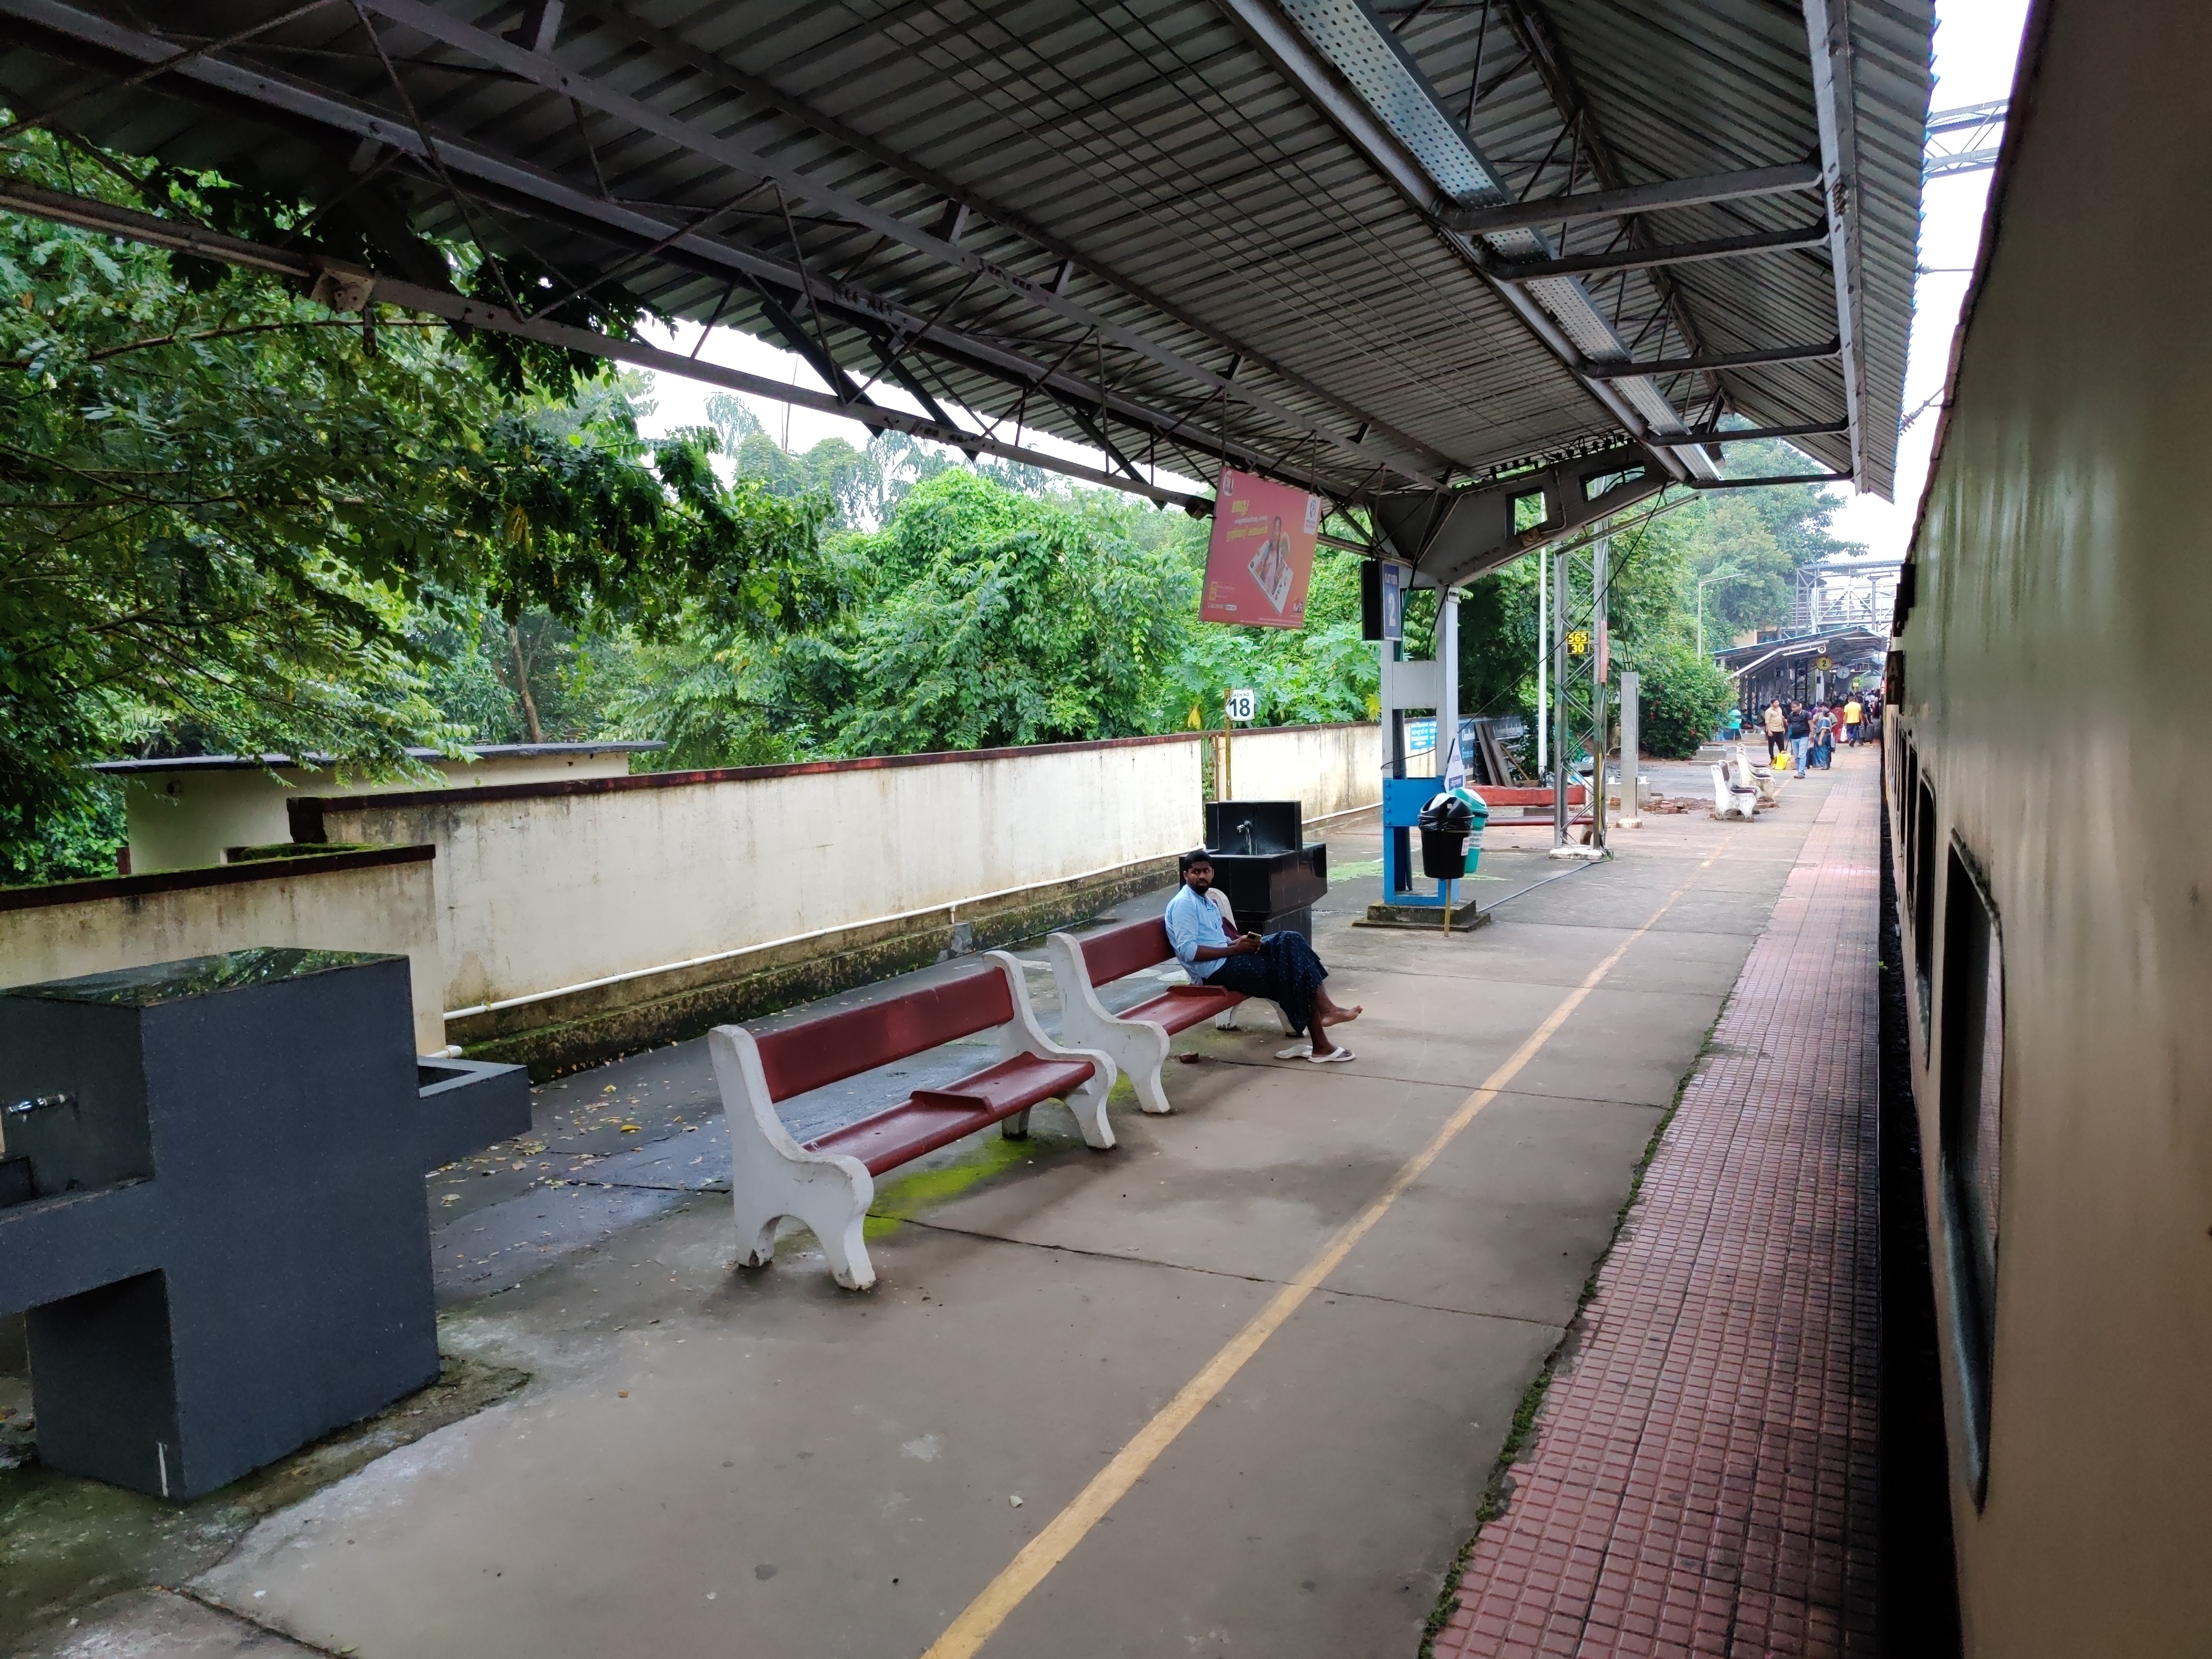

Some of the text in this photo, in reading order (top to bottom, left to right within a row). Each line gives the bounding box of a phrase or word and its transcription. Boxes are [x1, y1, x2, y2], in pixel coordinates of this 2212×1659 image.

[1389, 593, 1396, 627] 2
[1568, 633, 1587, 642] 565
[1572, 644, 1584, 653] 30
[1229, 698, 1250, 717] 18
